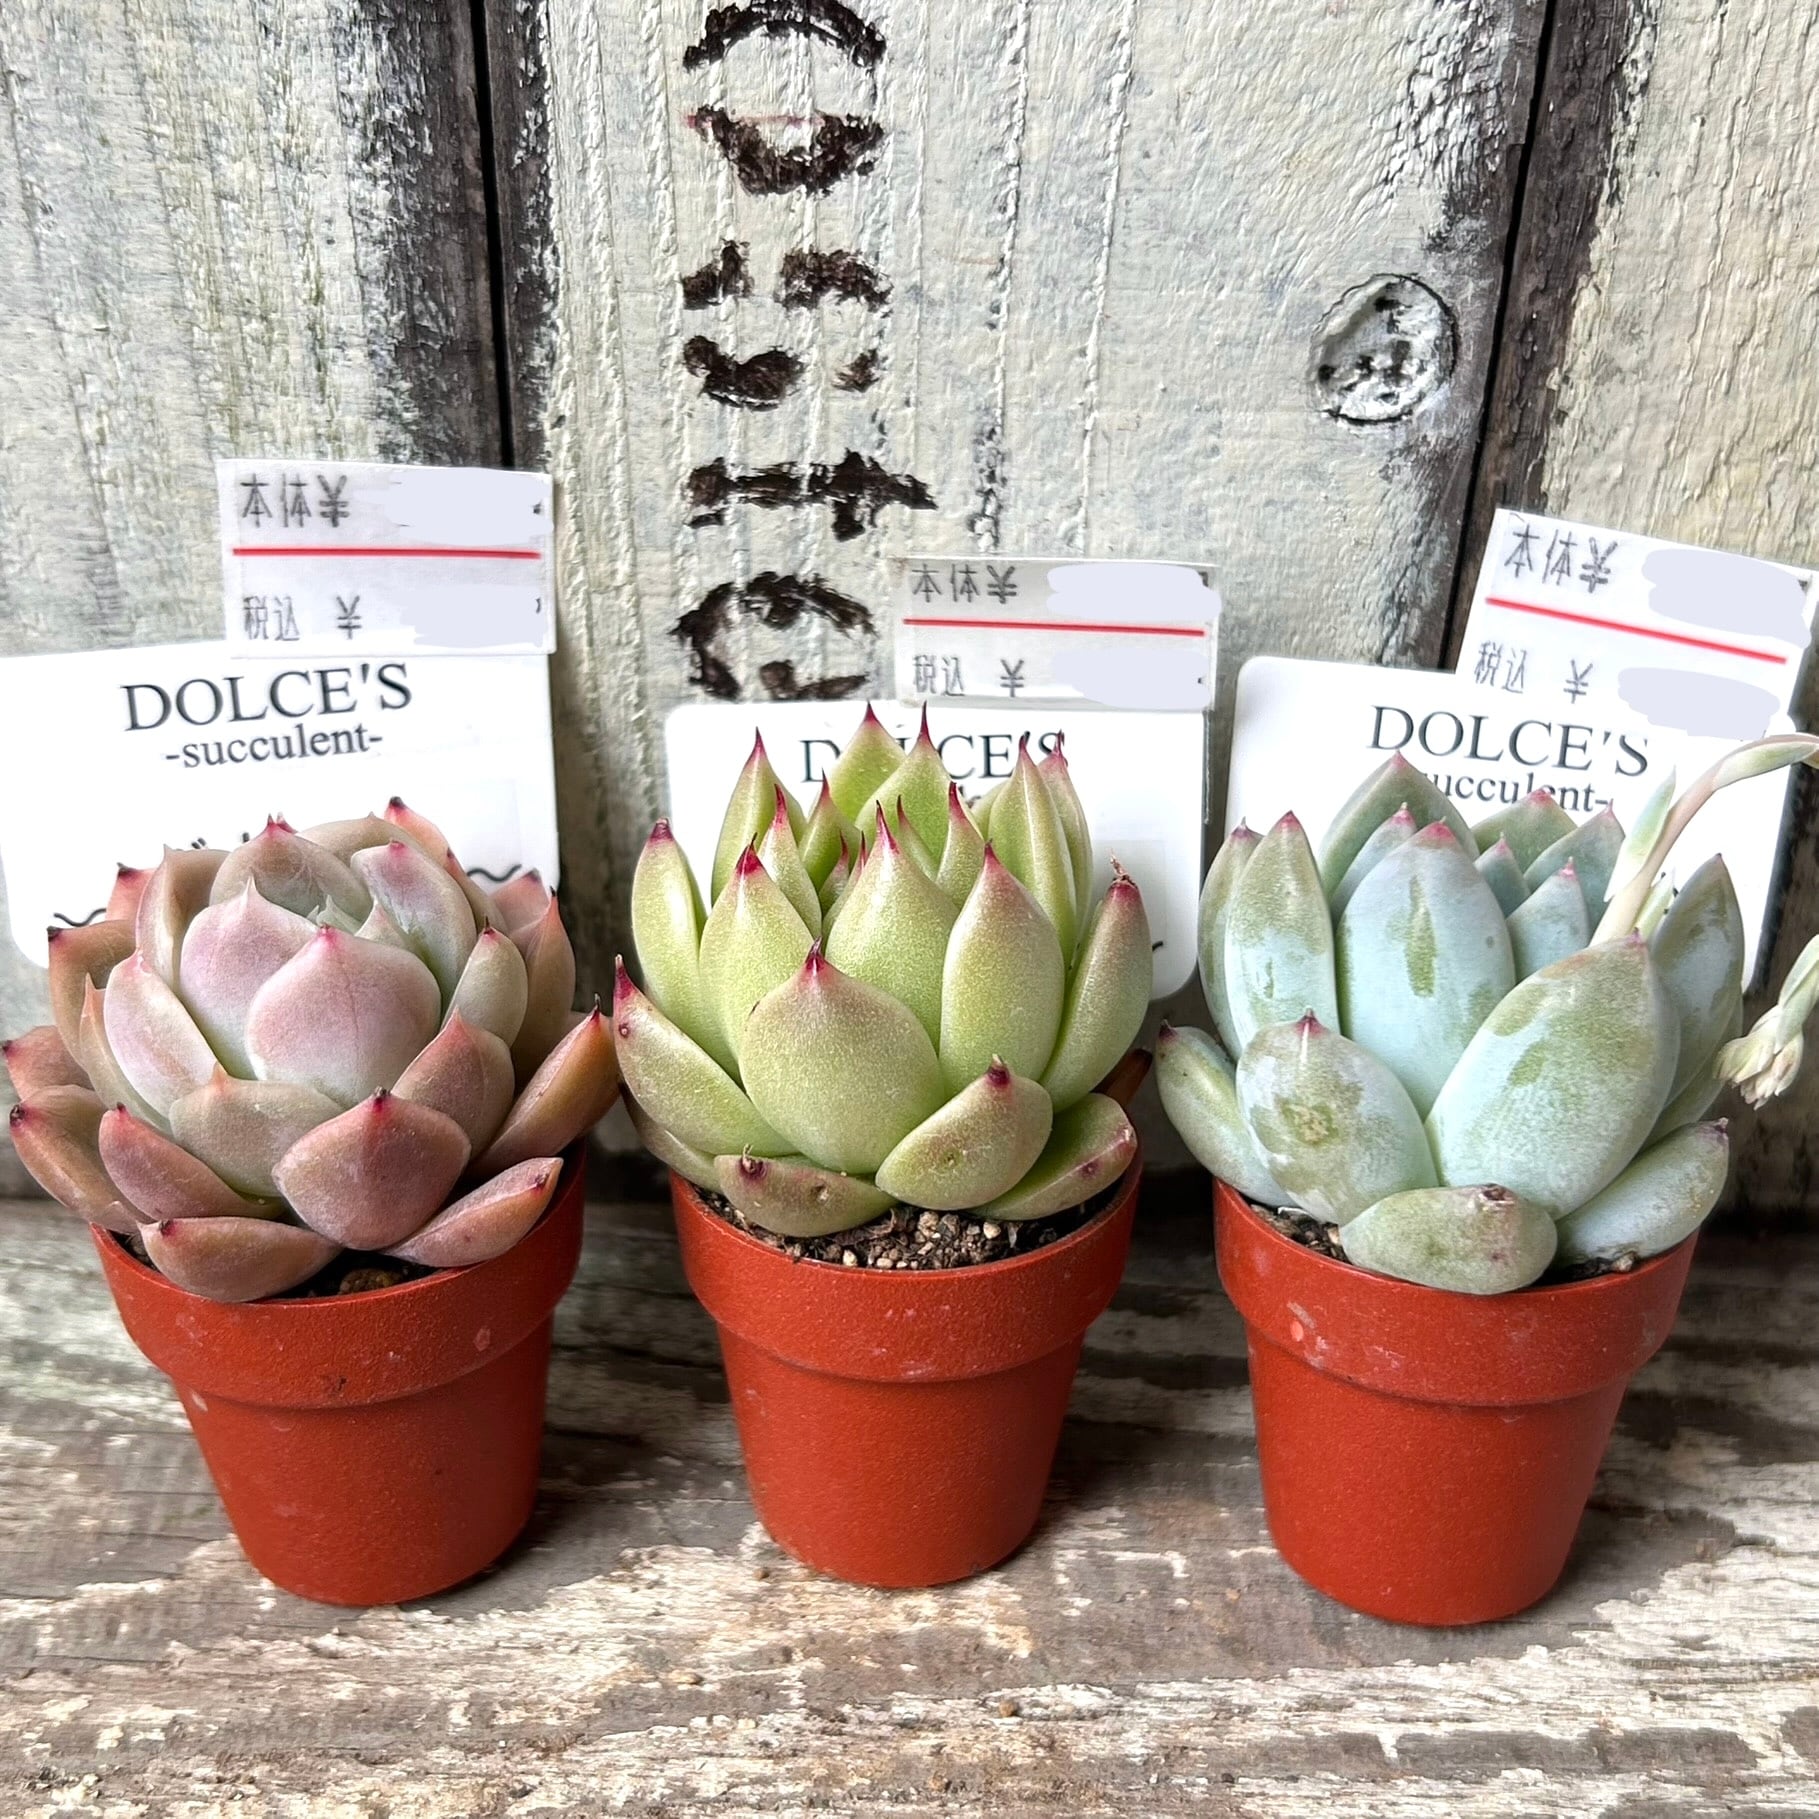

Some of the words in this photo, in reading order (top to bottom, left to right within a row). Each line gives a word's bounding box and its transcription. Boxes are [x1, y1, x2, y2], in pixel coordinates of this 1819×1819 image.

[120, 662, 412, 731] DOLCE'S
[166, 723, 383, 768] -succulent-
[1366, 705, 1648, 777] DOLCE'S
